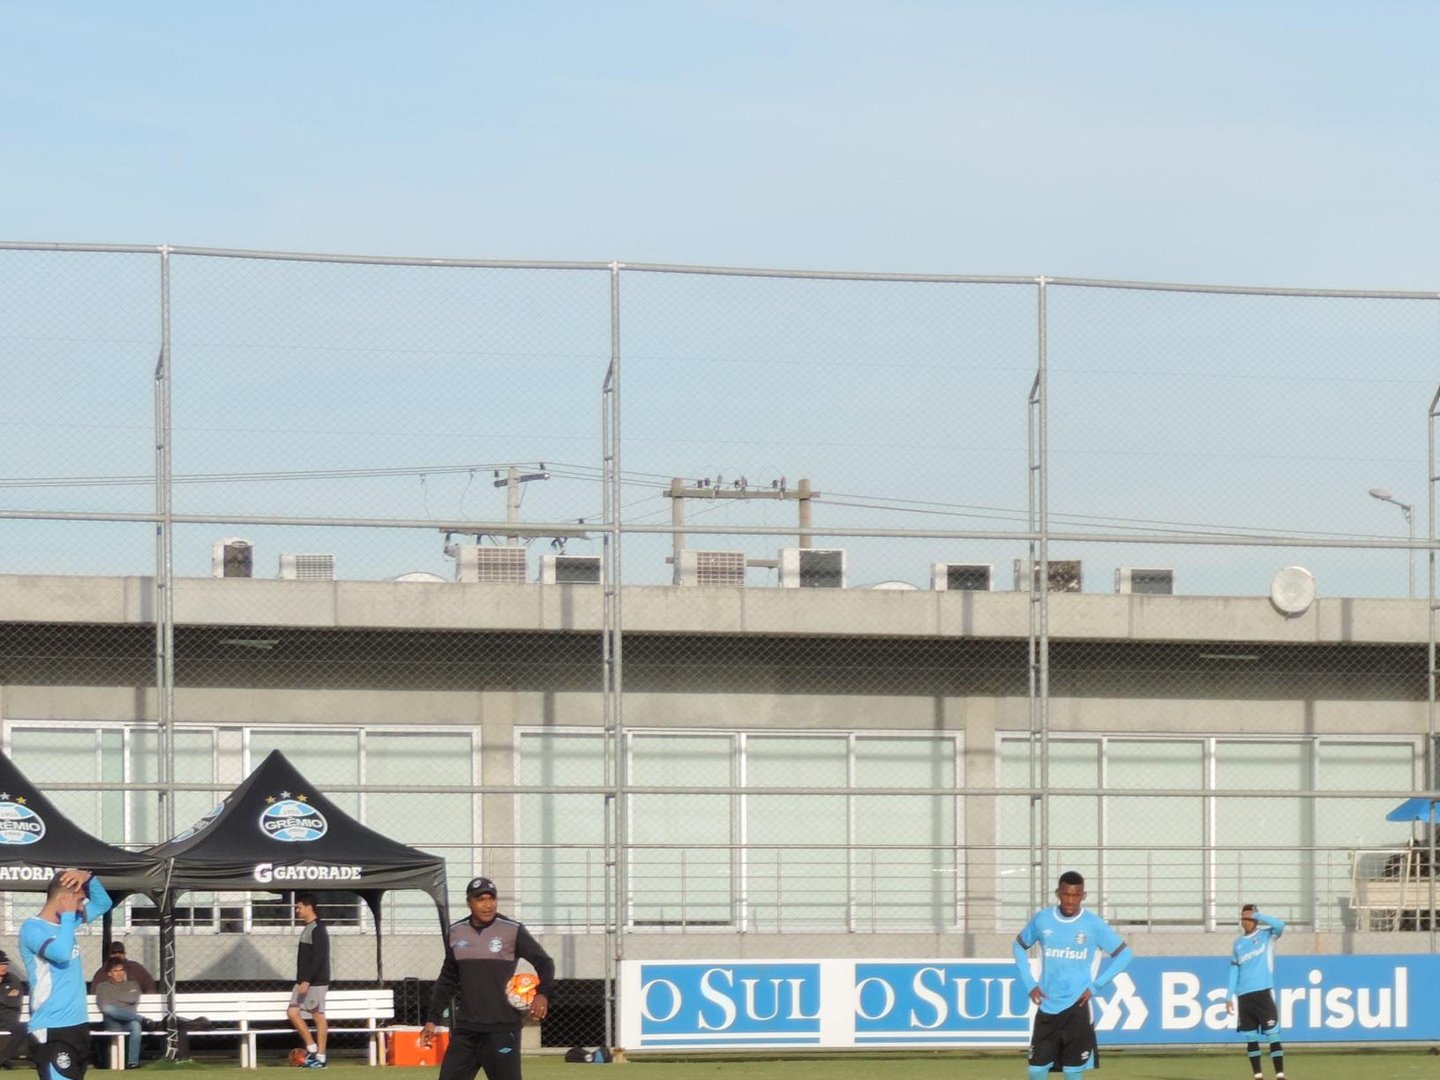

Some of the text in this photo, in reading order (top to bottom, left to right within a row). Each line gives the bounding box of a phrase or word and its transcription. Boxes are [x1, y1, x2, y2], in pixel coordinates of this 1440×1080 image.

[264, 816, 323, 830] GRÊMIO
[273, 866, 362, 880] GATORADE
[641, 967, 821, 1031] O SUL
[854, 966, 1030, 1029] O SUL
[1162, 966, 1408, 1030] Barisul
